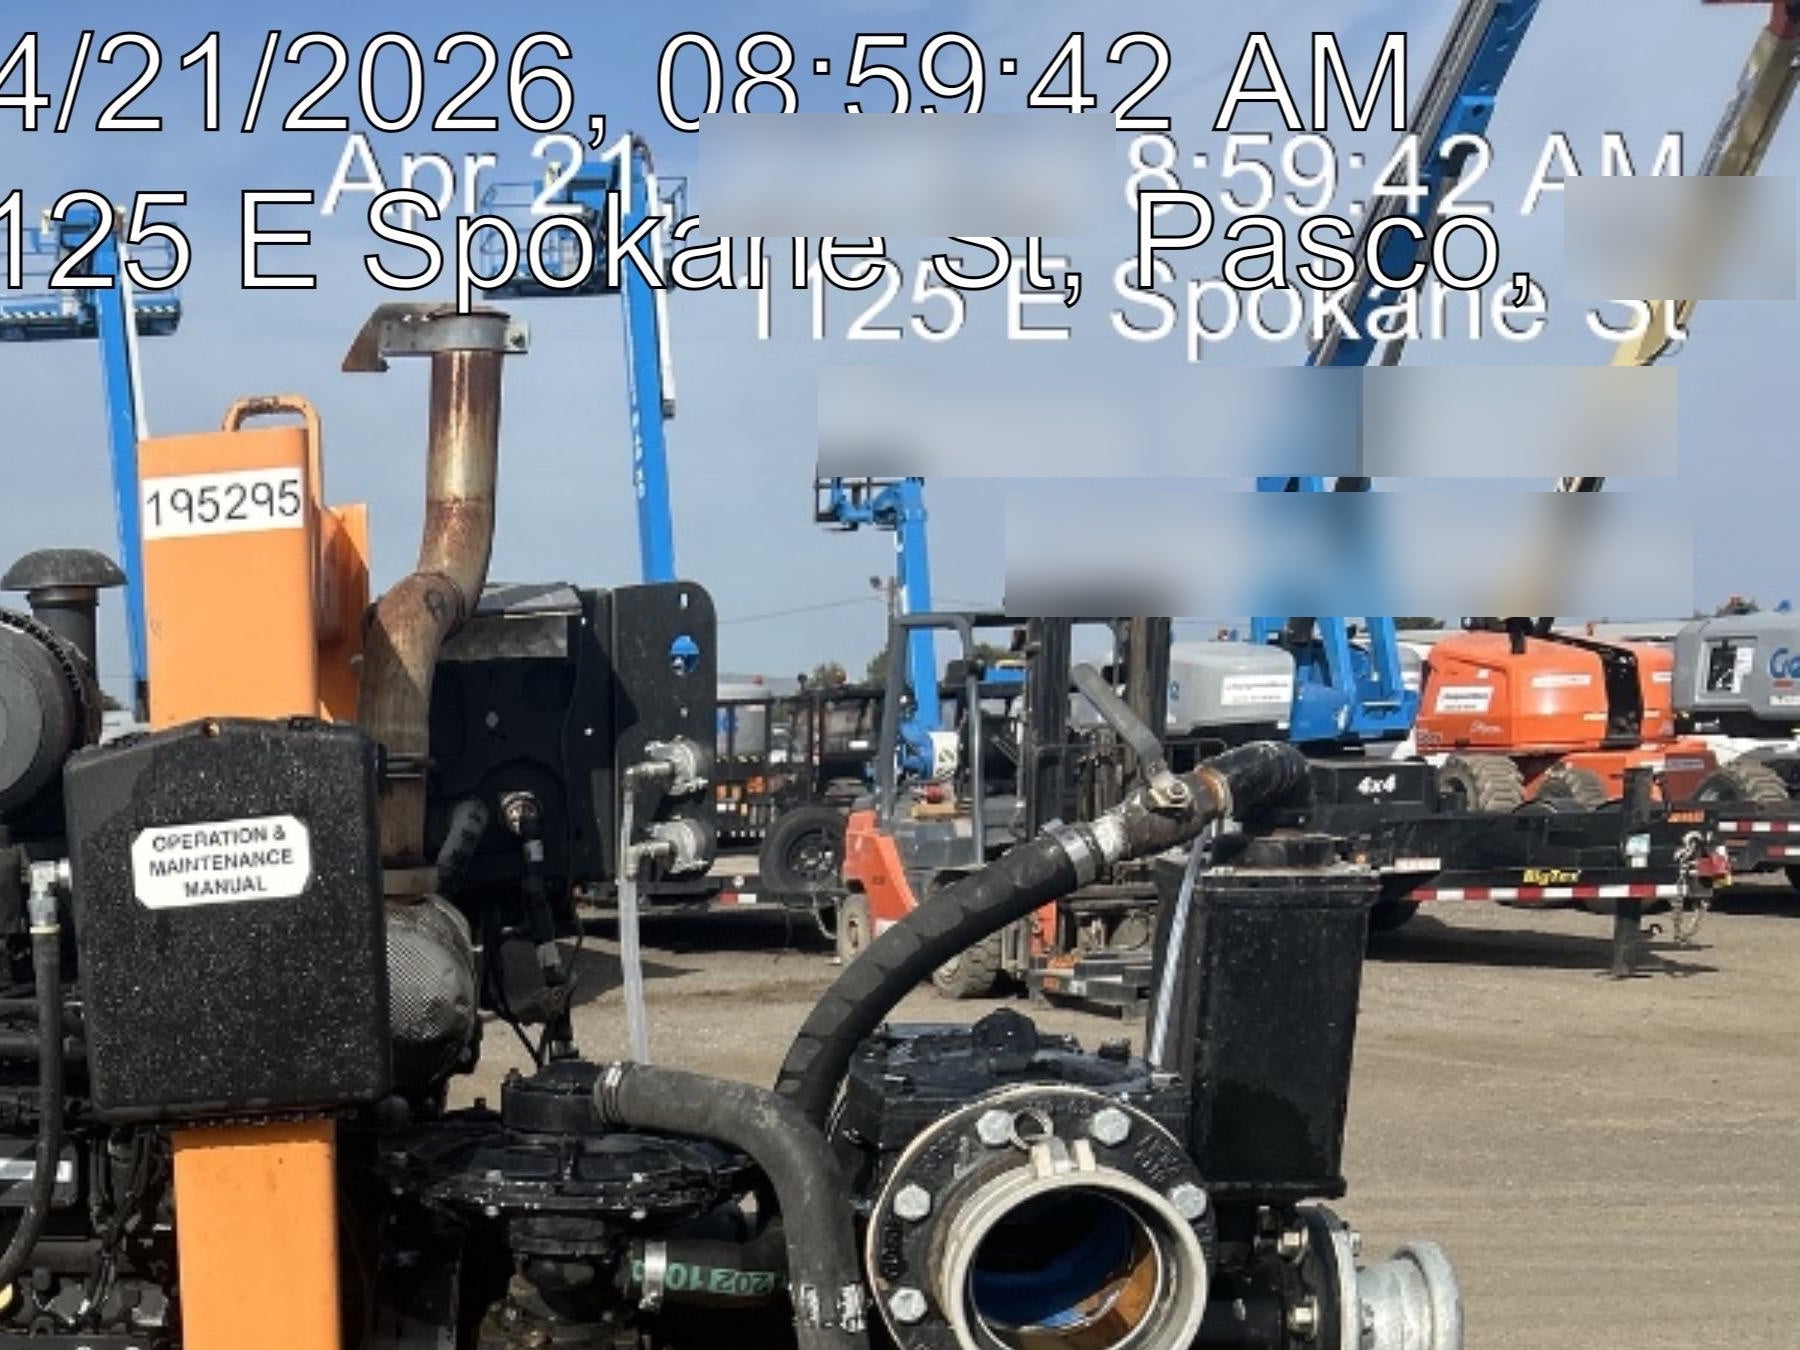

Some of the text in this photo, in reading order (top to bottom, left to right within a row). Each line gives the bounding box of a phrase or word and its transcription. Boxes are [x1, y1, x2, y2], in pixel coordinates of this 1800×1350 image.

[146, 479, 301, 527] 195295
[151, 823, 287, 853] OPERATION &
[149, 847, 295, 878] MAINTENANCE
[184, 874, 268, 899] MANUAL
